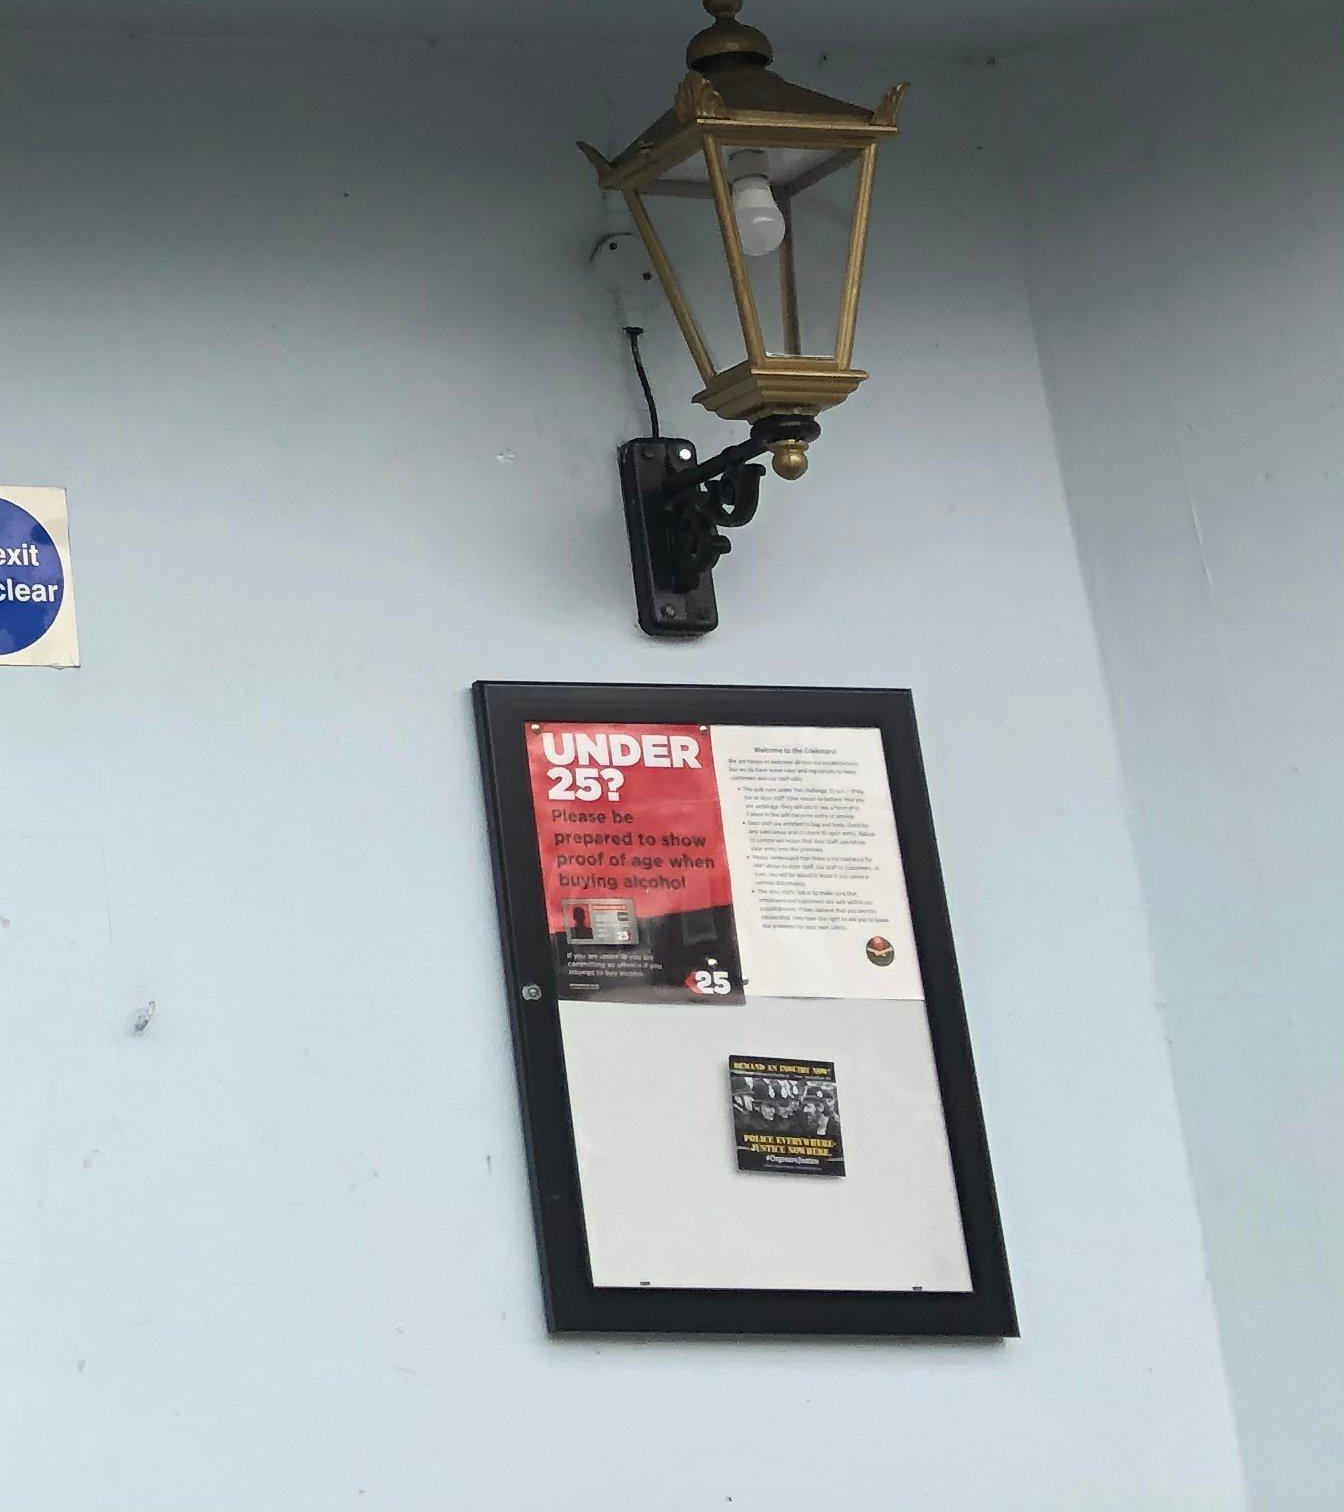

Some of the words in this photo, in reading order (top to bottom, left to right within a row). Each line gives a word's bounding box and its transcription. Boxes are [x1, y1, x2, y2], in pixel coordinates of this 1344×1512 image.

[541, 732, 703, 768] UNDER
[546, 766, 625, 802] 25?
[551, 809, 605, 824] Please
[612, 809, 634, 824] be
[554, 833, 632, 846] prepared
[638, 834, 656, 846] to
[661, 833, 706, 847] show
[556, 852, 604, 868] proof
[609, 853, 627, 866] of
[631, 855, 662, 869] age
[670, 854, 715, 868] when
[559, 874, 617, 889] buying
[623, 875, 687, 889] alcohol
[694, 970, 732, 995] 25
